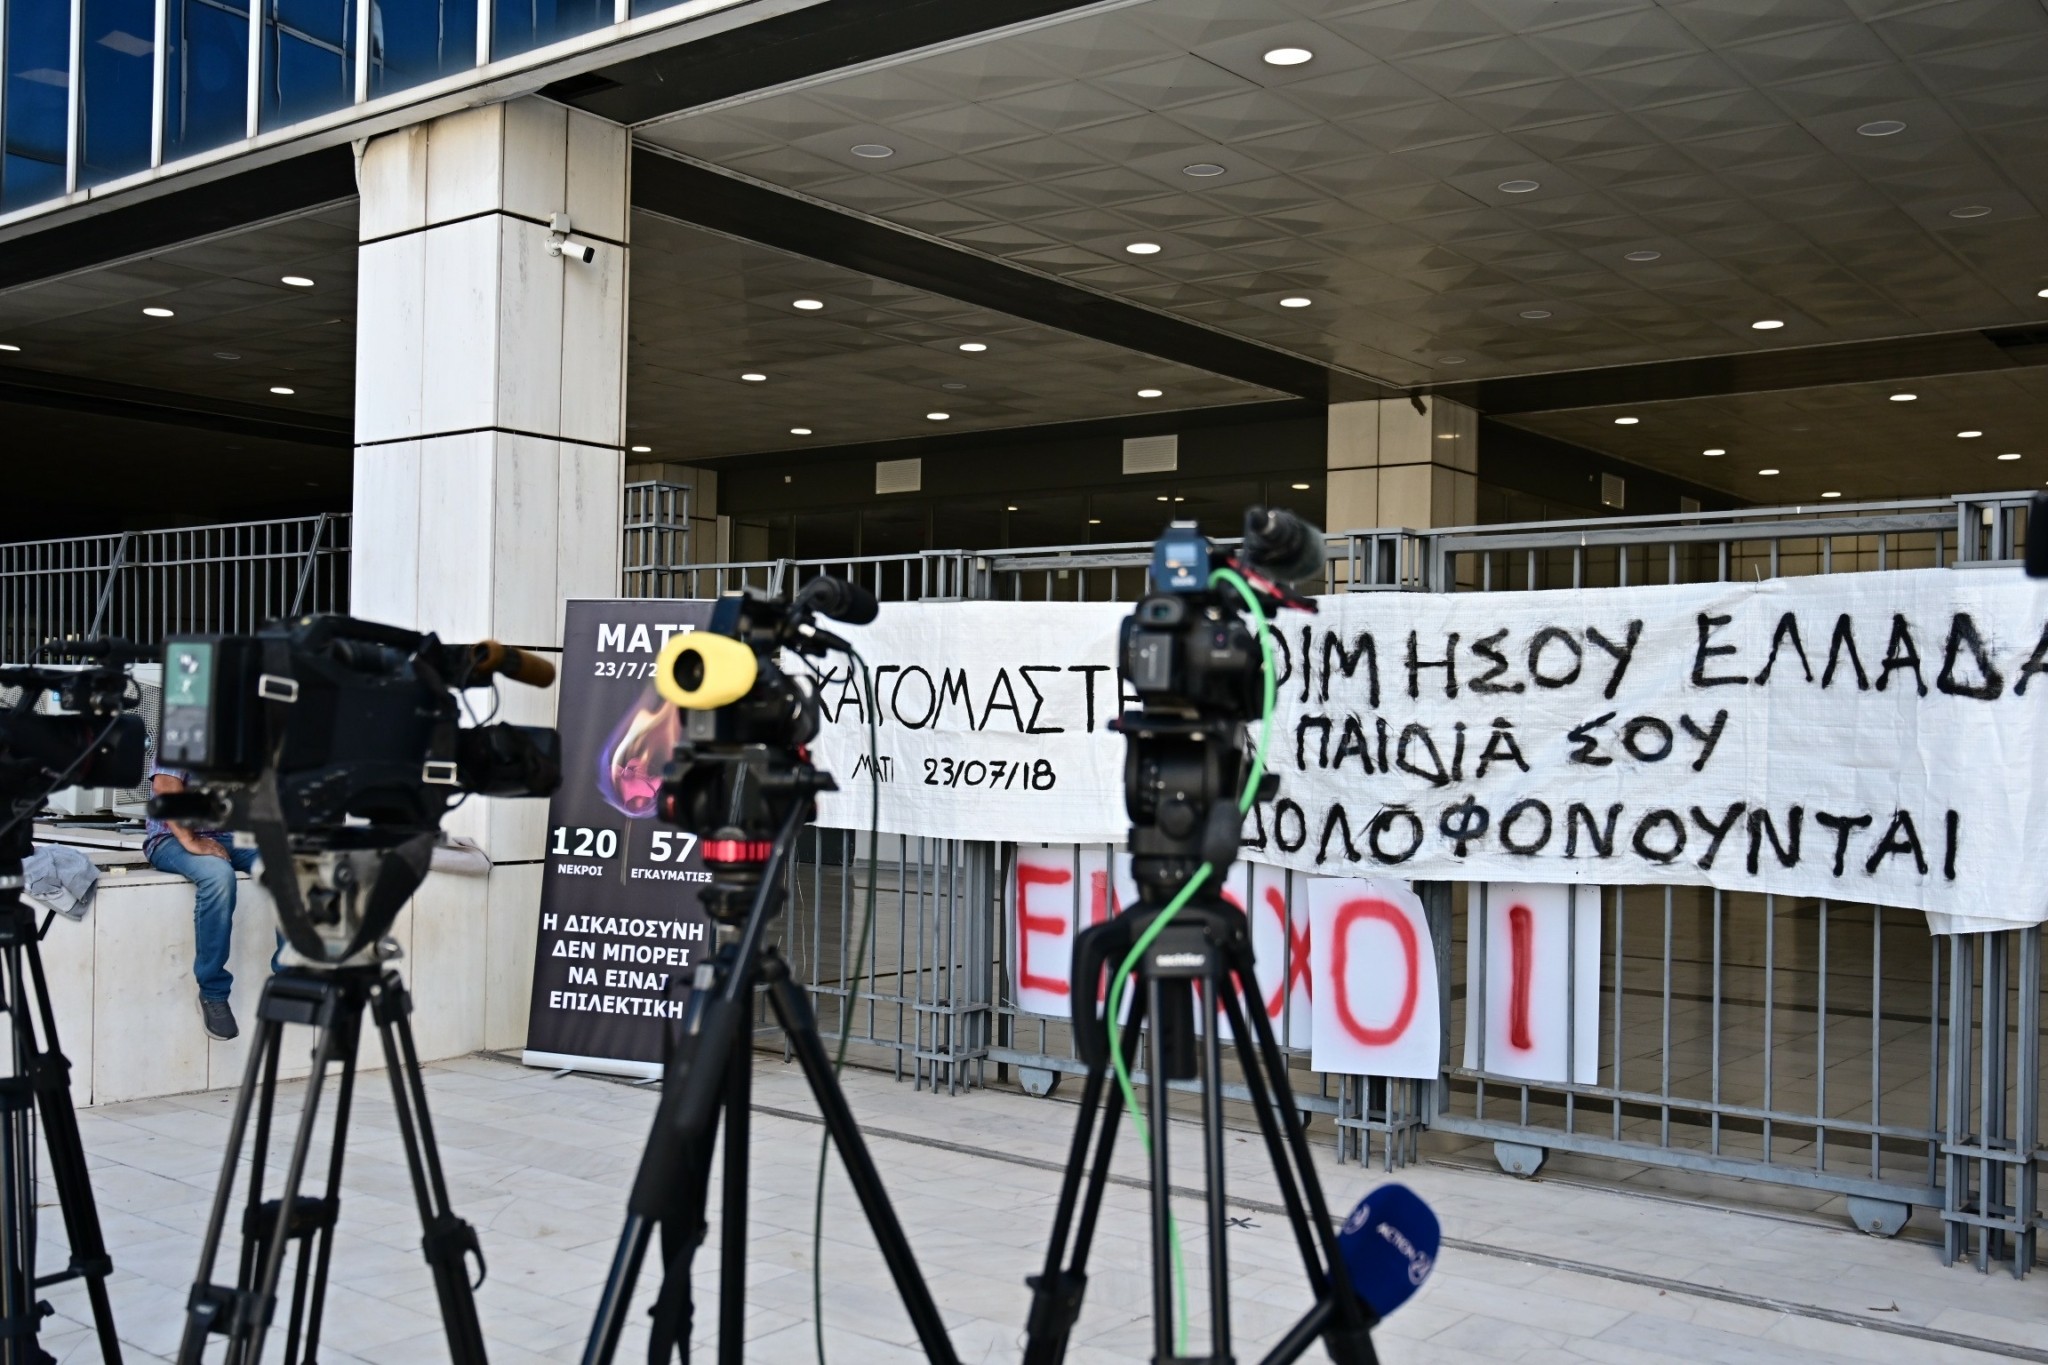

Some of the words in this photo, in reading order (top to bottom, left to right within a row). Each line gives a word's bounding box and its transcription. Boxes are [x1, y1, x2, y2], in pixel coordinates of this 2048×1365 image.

[597, 623, 695, 653] ΜΑΤ
[1296, 712, 1530, 787] ΠΑΙΔΙΑ
[1568, 709, 1728, 772] ΣΟΥ
[852, 753, 894, 783] ΜΑΤΙ
[924, 758, 1056, 790] 23/07/18
[551, 826, 617, 858] 120
[649, 831, 697, 862] 57
[557, 864, 603, 876] ΝΕΚΡΟΙ
[630, 867, 712, 883] ΕΓΚΑΥΜΑΤΙΕΣ
[542, 912, 558, 931] Η
[564, 914, 704, 941] ΔΙΚΑΙΟΣΥΝΗ
[551, 940, 596, 960] ΔΕΝ
[602, 943, 690, 966] ΜΠΟΡΕΙ
[568, 966, 599, 986] ΝΑ
[604, 970, 669, 991] ΕΙΝΑΙ
[549, 990, 684, 1019] ΕΠΙΛΕΚΤΙΚΗ
